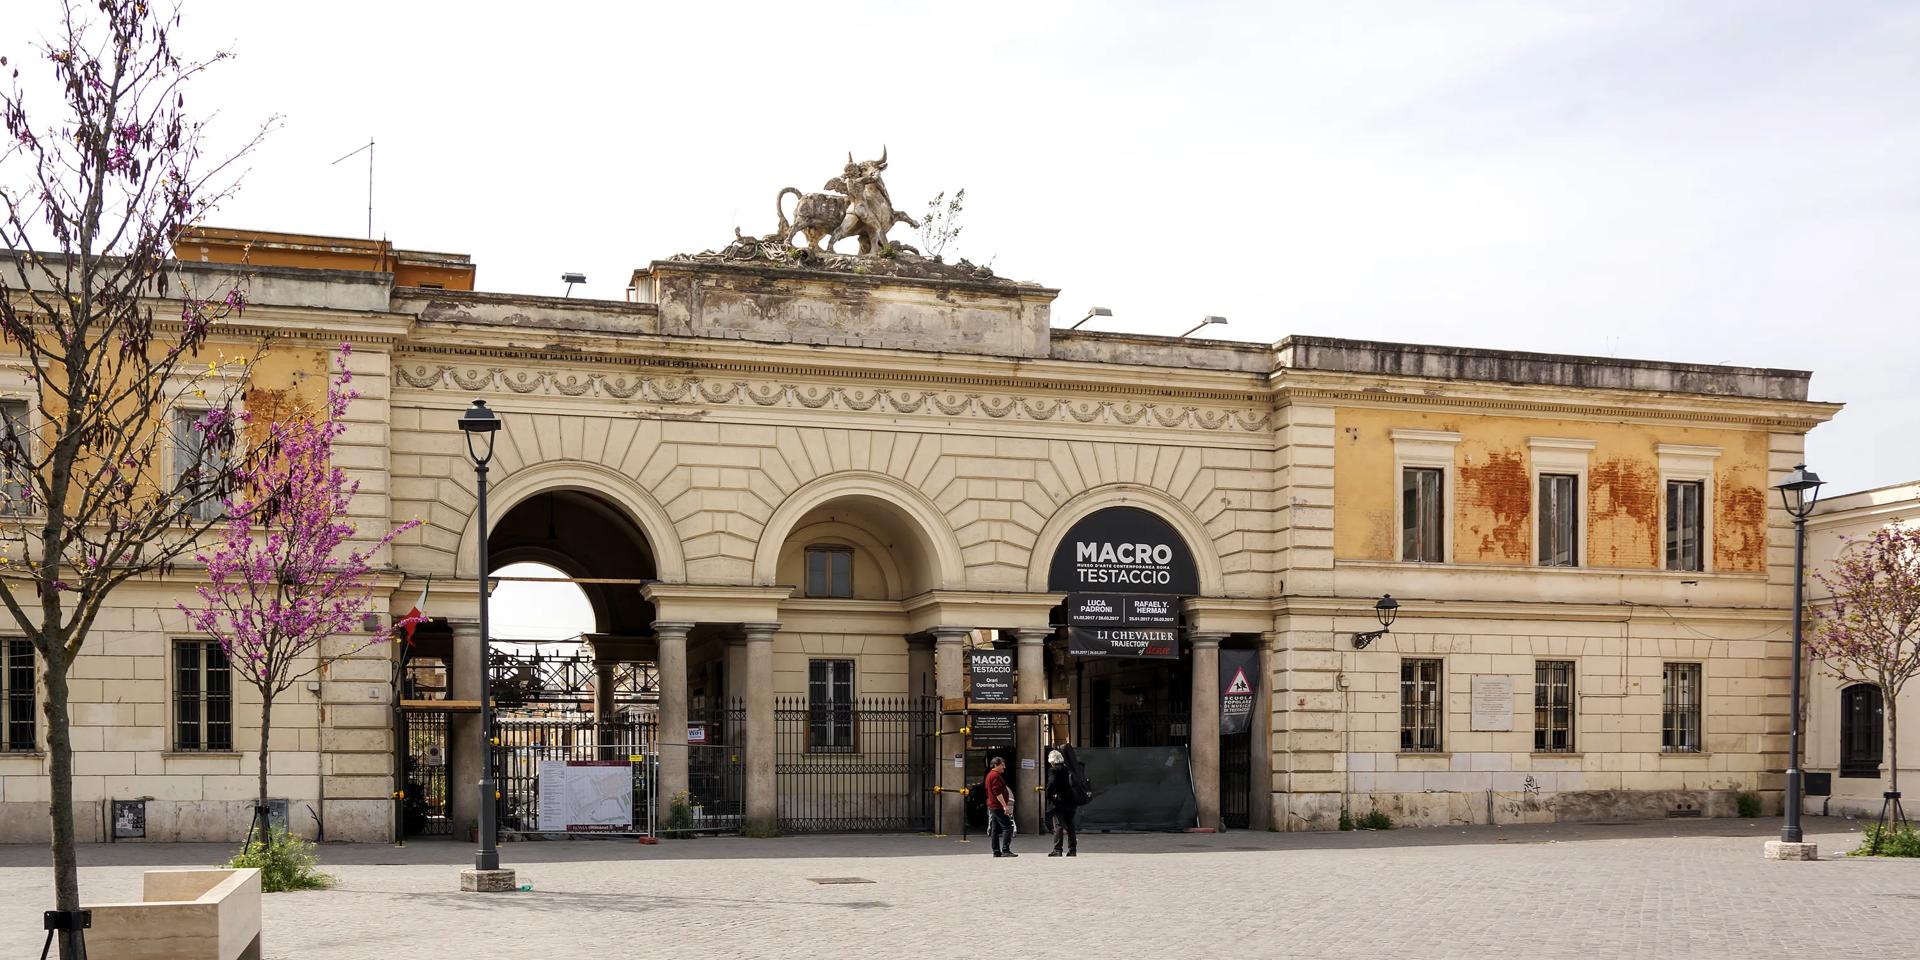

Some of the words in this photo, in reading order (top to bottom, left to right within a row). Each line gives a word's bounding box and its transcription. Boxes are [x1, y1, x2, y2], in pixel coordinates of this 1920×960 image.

[1077, 542, 1172, 564] MACRO
[1077, 568, 1170, 584] TESTACCIO
[1134, 600, 1161, 608] RAFAEL
[1097, 631, 1108, 639] LI
[1112, 631, 1174, 641] CHEVALIER
[1110, 640, 1149, 648] TRAJECTORY
[1138, 647, 1145, 656] of
[972, 655, 1011, 664] MACRO
